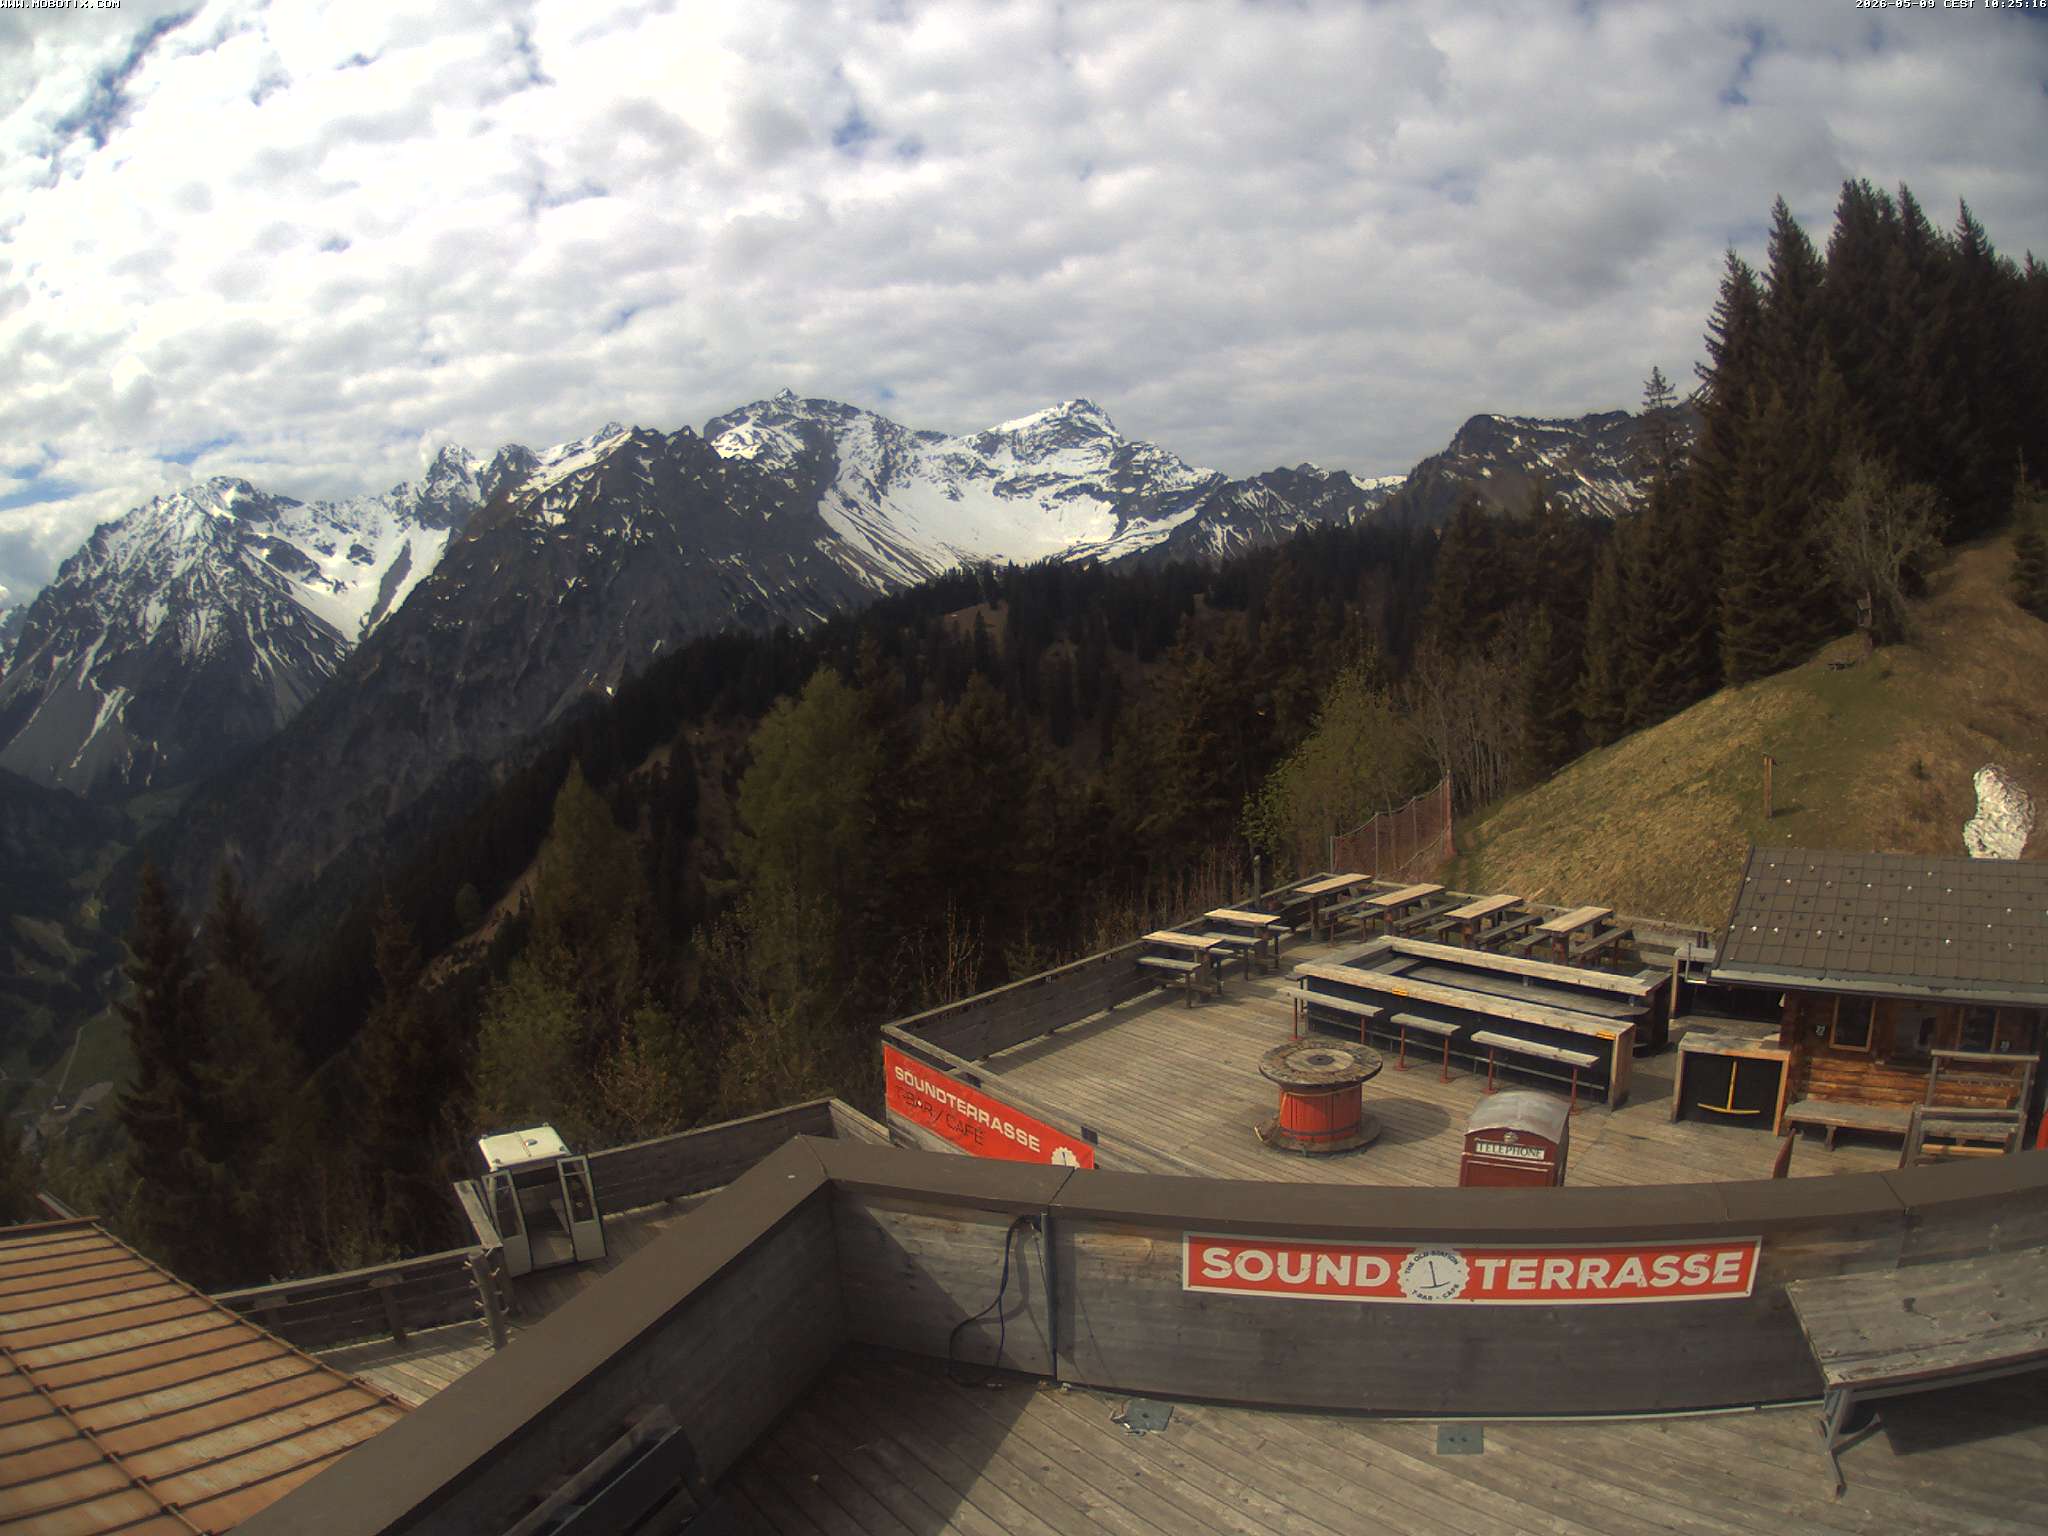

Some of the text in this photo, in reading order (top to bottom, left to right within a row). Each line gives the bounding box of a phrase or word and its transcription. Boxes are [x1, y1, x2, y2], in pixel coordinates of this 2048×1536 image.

[894, 1066, 1041, 1153] SOUNDTERRASSE
[1476, 1142, 1543, 1159] TELEPHONE
[1201, 1247, 1743, 1290] SOUND TERRASSE
